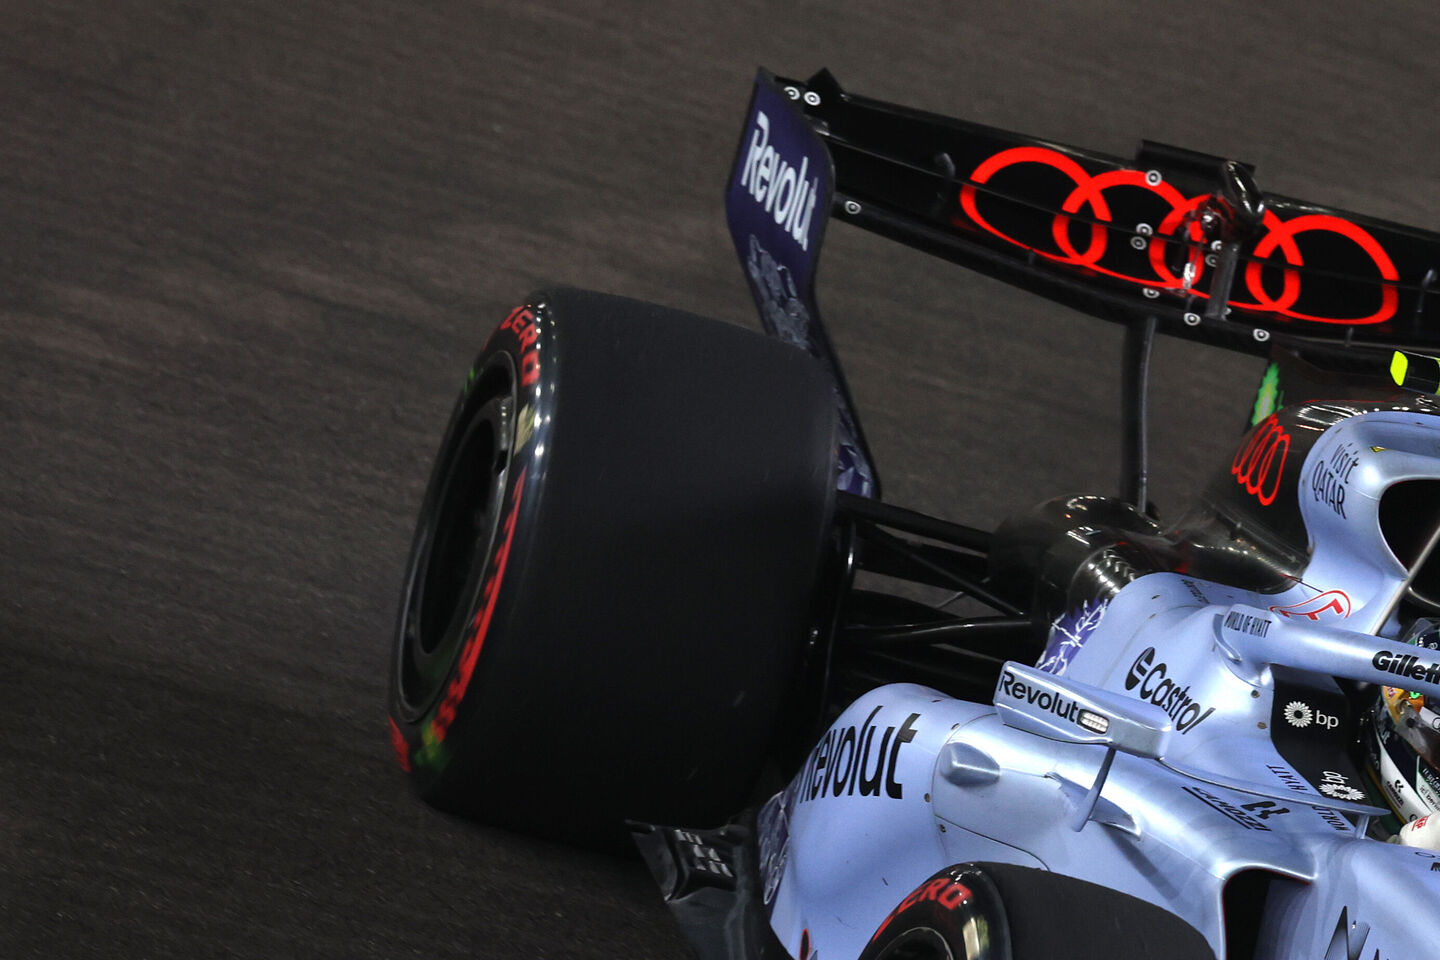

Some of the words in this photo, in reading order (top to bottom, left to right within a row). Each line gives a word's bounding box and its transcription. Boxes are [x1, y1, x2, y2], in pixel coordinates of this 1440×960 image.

[740, 110, 818, 252] Revolut
[1330, 442, 1359, 485] visit
[1312, 460, 1347, 520] QATAR
[999, 671, 1079, 723] Revolut
[1140, 663, 1216, 735] Castrol
[1315, 710, 1339, 730] bp
[1266, 764, 1308, 792] HYATT
